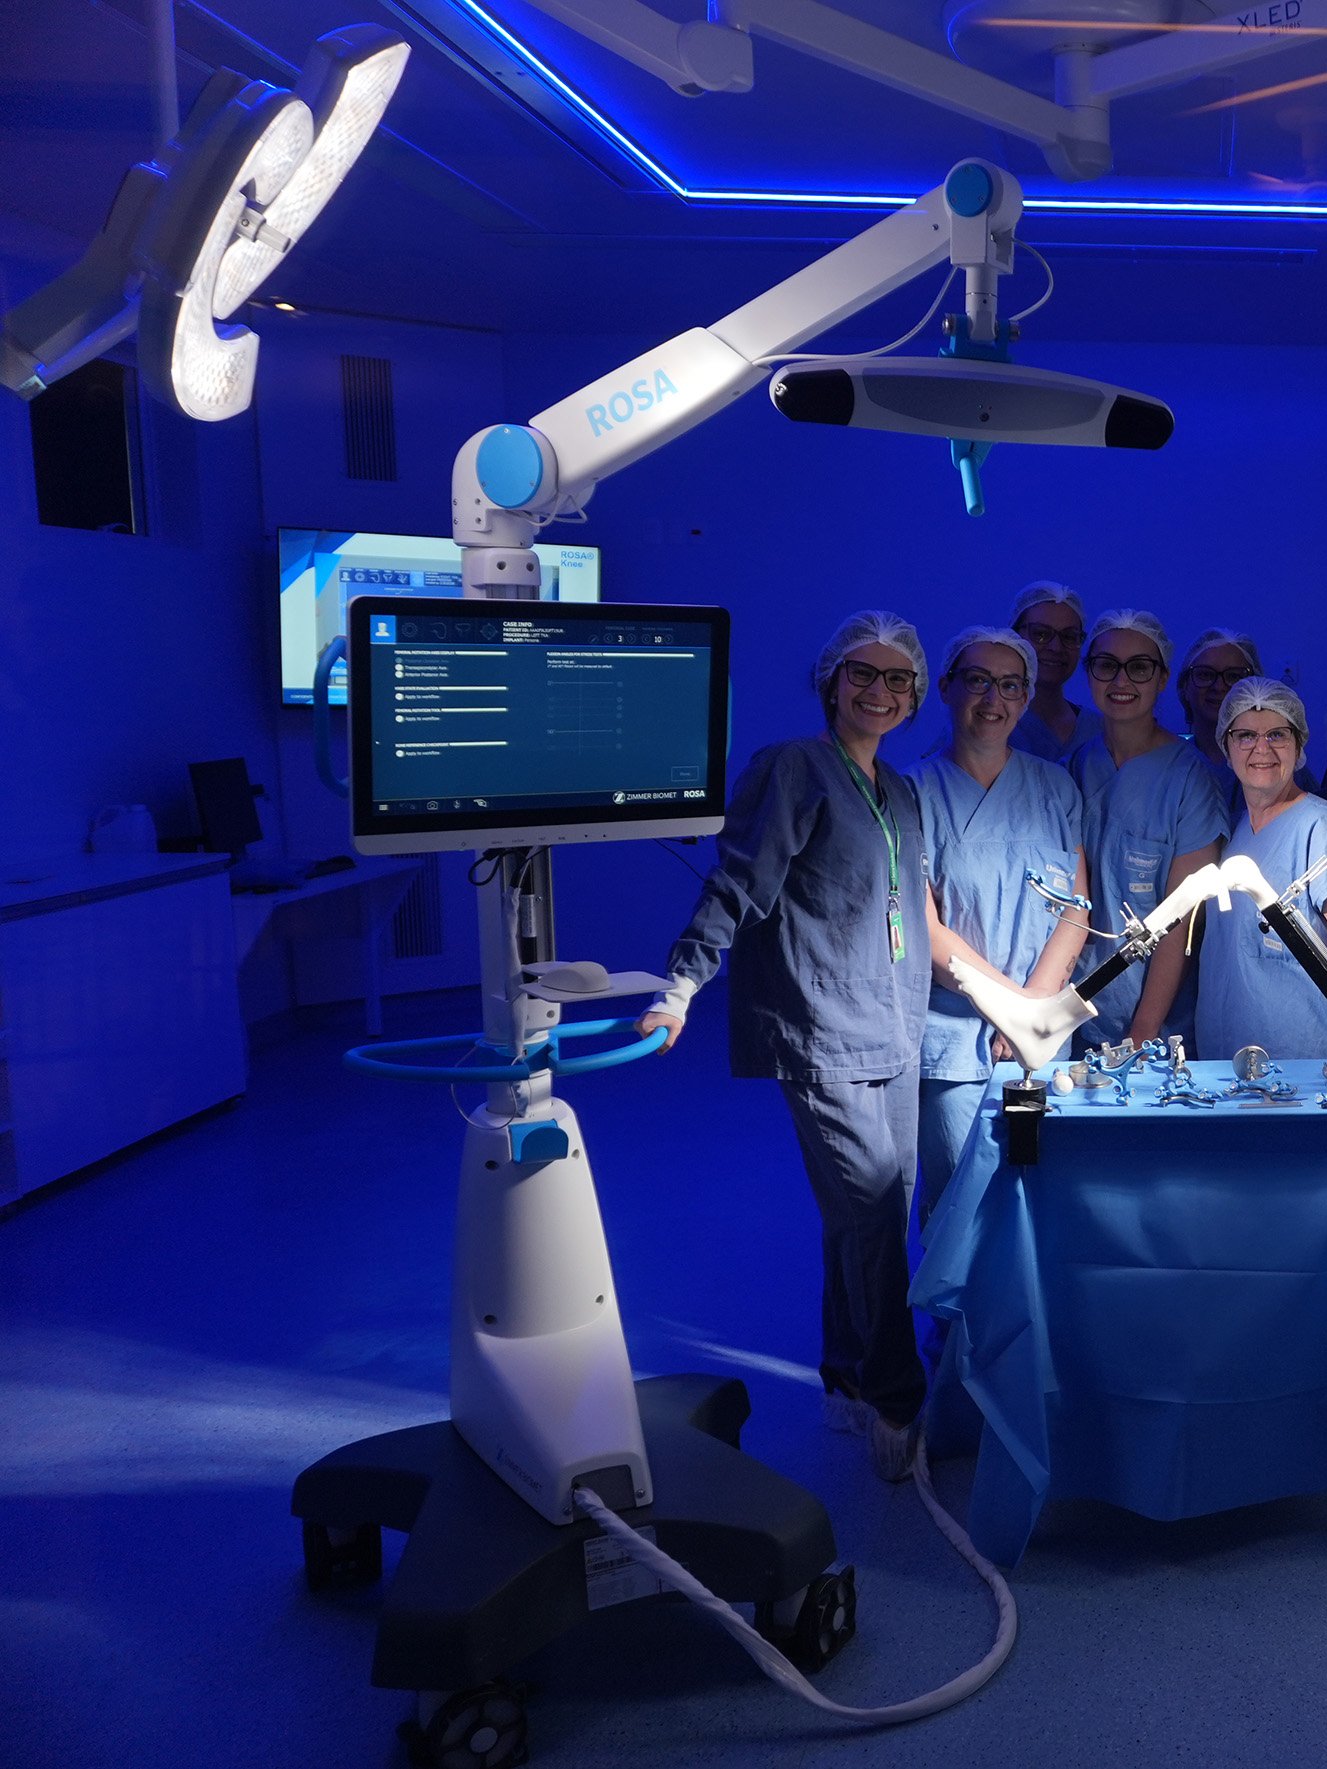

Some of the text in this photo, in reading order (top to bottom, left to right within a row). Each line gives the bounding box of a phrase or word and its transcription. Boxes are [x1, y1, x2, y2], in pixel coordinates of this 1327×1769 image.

[1237, 0, 1301, 35] XLED
[585, 368, 678, 437] ROSA
[617, 635, 623, 643] 3
[683, 790, 705, 798] ROSA
